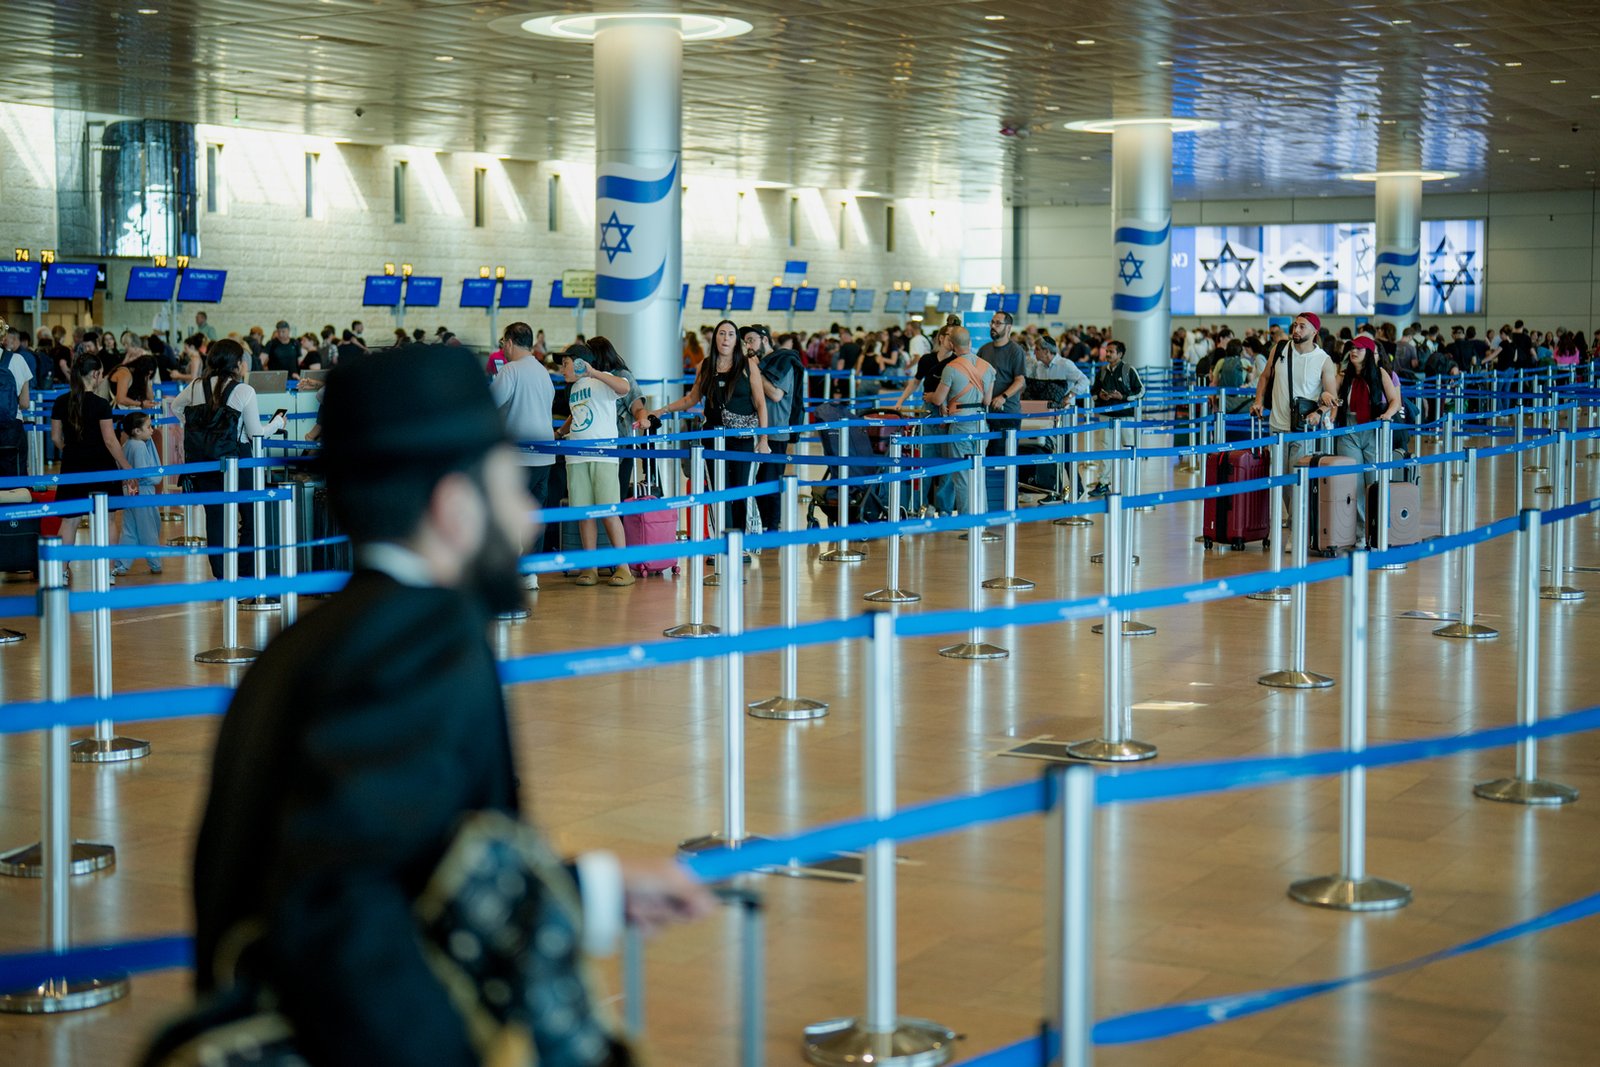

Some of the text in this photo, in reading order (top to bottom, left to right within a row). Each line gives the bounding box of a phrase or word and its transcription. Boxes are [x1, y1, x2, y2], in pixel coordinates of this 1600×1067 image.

[16, 249, 29, 261] 74
[41, 250, 54, 263] 75
[177, 255, 189, 267] 77
